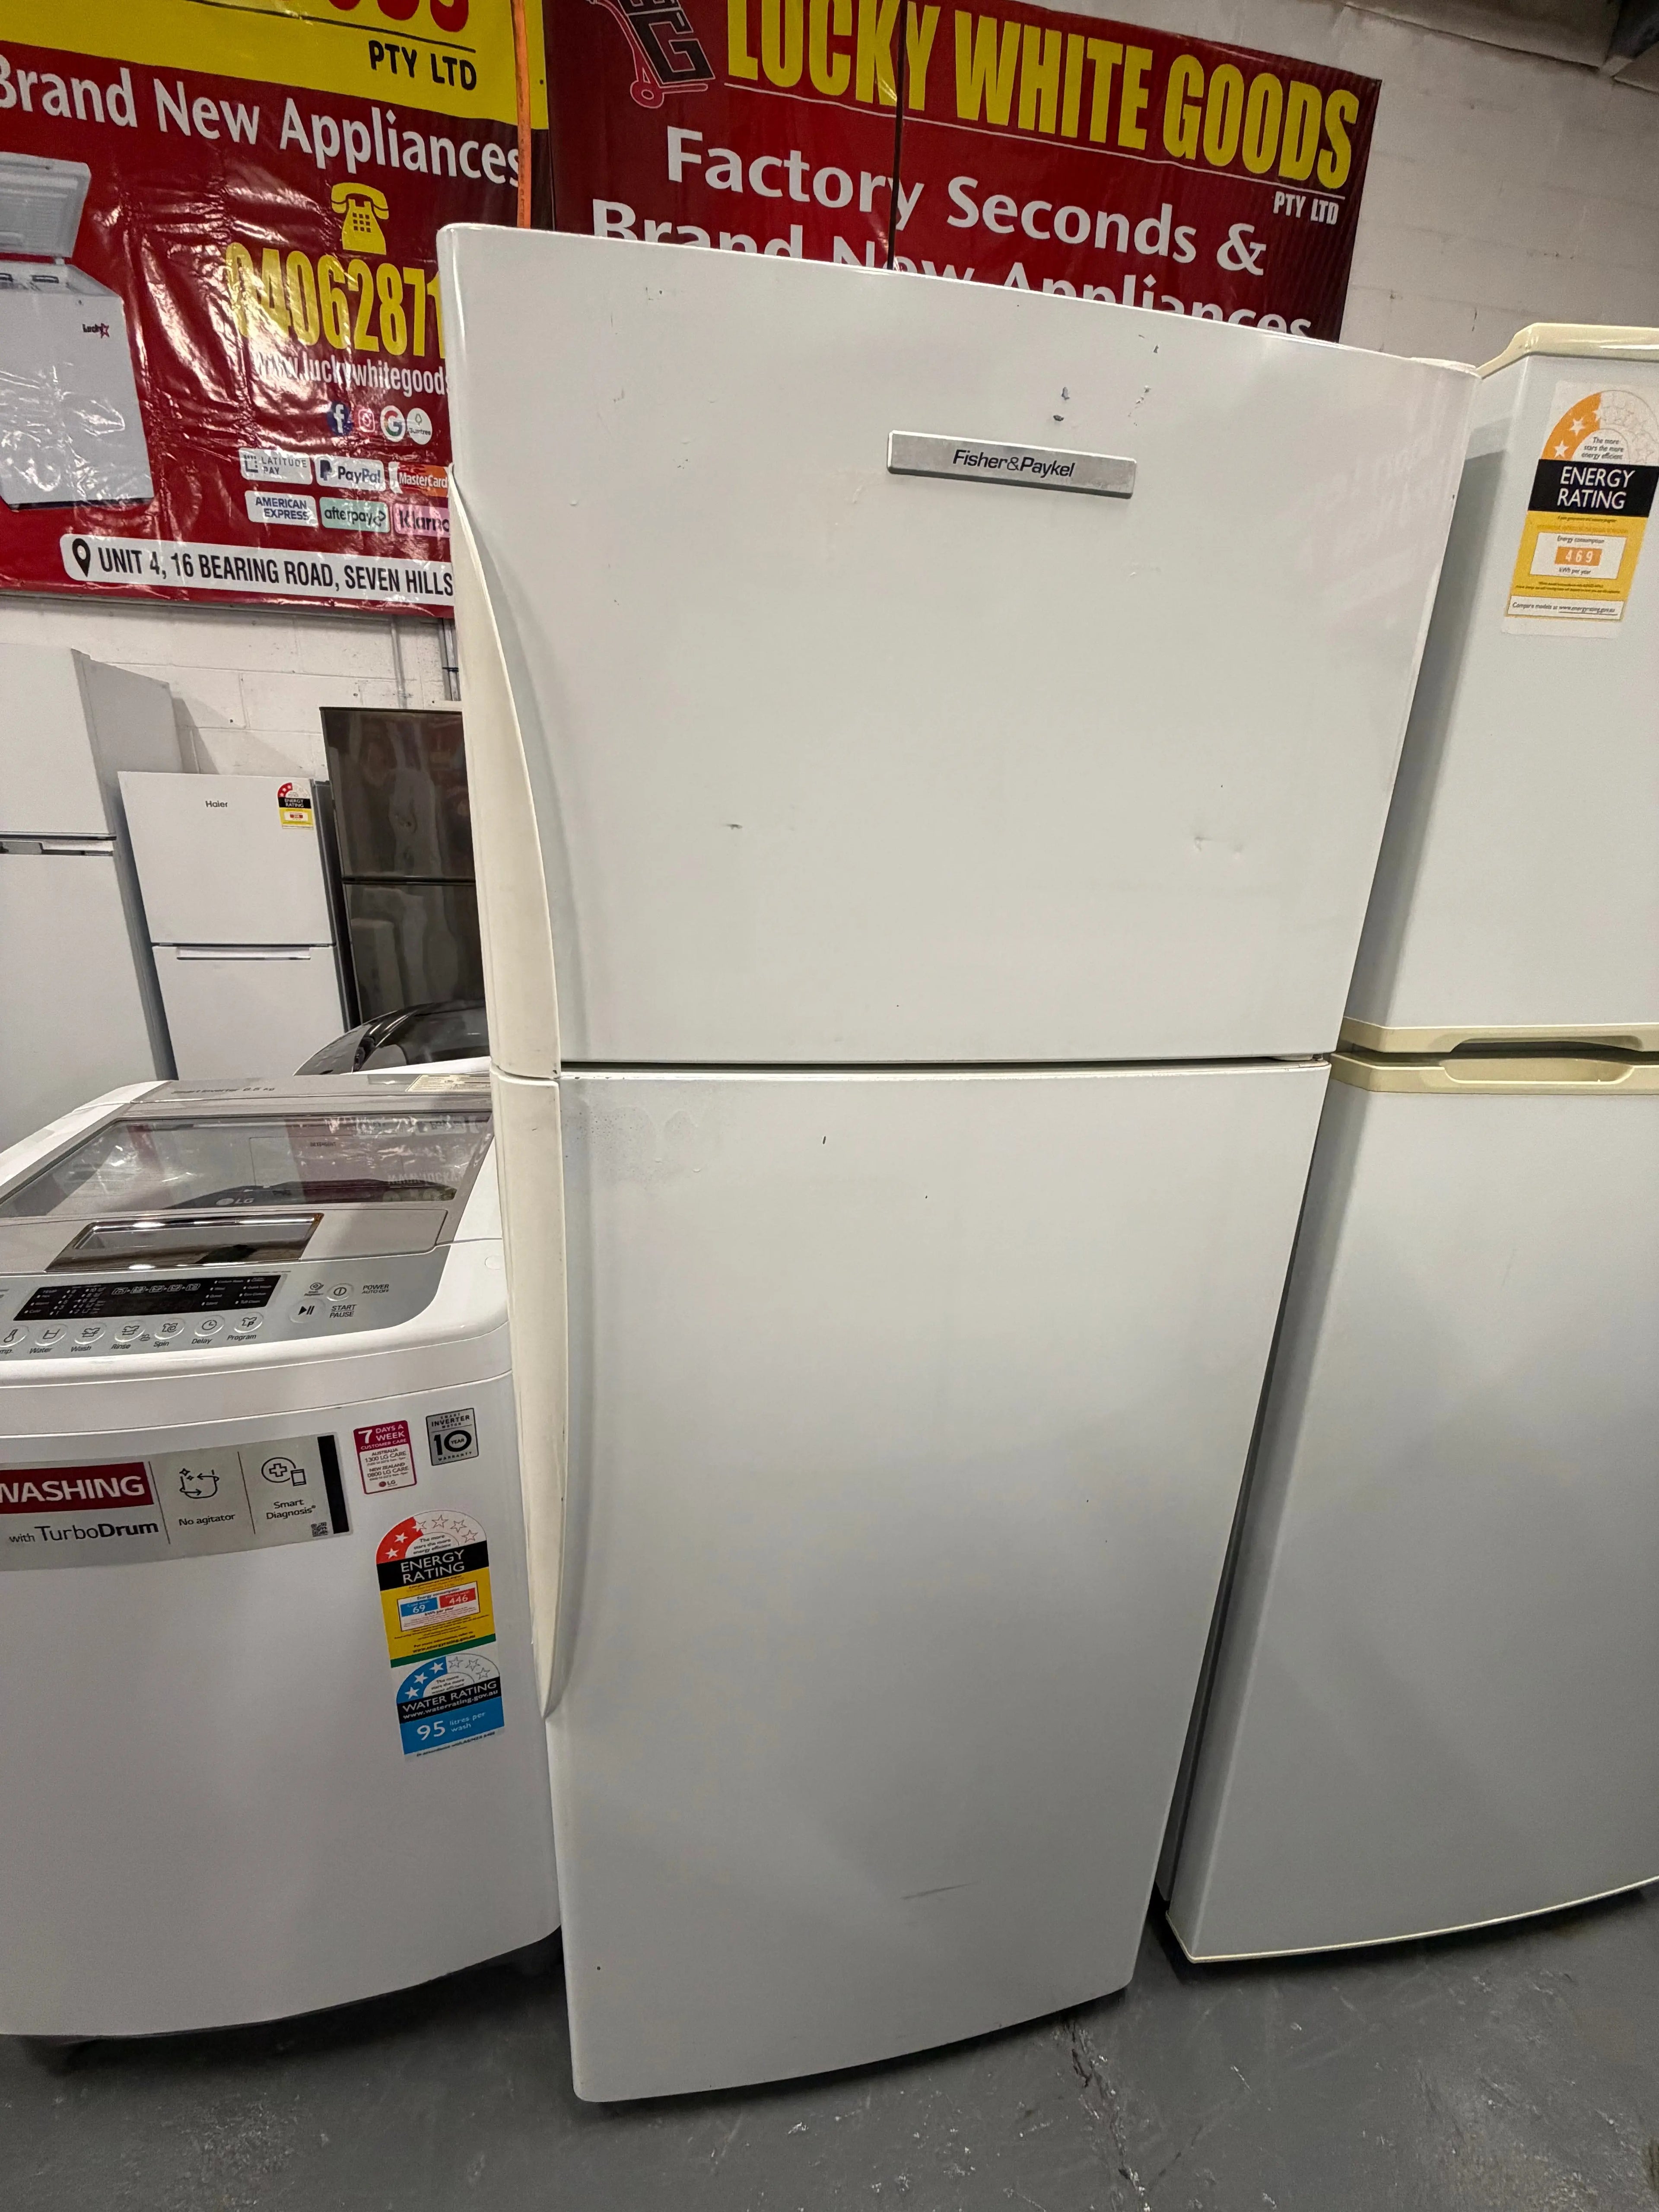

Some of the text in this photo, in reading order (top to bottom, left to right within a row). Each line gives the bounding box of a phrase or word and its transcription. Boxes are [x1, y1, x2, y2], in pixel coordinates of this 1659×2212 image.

[368, 40, 476, 90] PTY LTD
[727, 0, 1360, 189] LUCKY WHITE GOODS
[0, 54, 519, 187] Brand New Appliances
[667, 126, 1267, 276] Factory Seconds &
[1273, 191, 1339, 225] PTY LTD
[261, 456, 307, 468] LATITUDE
[264, 466, 280, 475] PAY
[953, 449, 1076, 478] Fisher&Paykel
[338, 466, 381, 484] PayPal
[399, 472, 448, 488] MasterCard
[1560, 466, 1636, 488] ENERGY
[255, 497, 308, 509] AMERICAN
[1557, 488, 1627, 510] RATING
[264, 508, 309, 520] EXPRESS
[324, 506, 372, 525] afterpay
[99, 547, 454, 596] UNIT 4, 16 BEARING ROAD, SEVEN HILLS
[432, 1415, 470, 1427] INVERTER
[358, 1429, 372, 1444] 7
[375, 1425, 395, 1434] DAYS
[375, 1430, 405, 1442] WEEK
[433, 1430, 472, 1456] 10
[361, 1441, 391, 1450] CUSTOMER
[372, 1448, 398, 1456] AUSTRALIA
[273, 1499, 304, 1509] Smart
[197, 1514, 235, 1525] agitator
[9, 1522, 159, 1543] with TurboDrum
[400, 1549, 465, 1573] ENERGY
[403, 1561, 465, 1584] RATING
[413, 1594, 468, 1614] 69 446
[402, 1681, 497, 1713] WATER RATING
[416, 1712, 485, 1741] 95 litres per
[451, 1723, 472, 1732] wash
